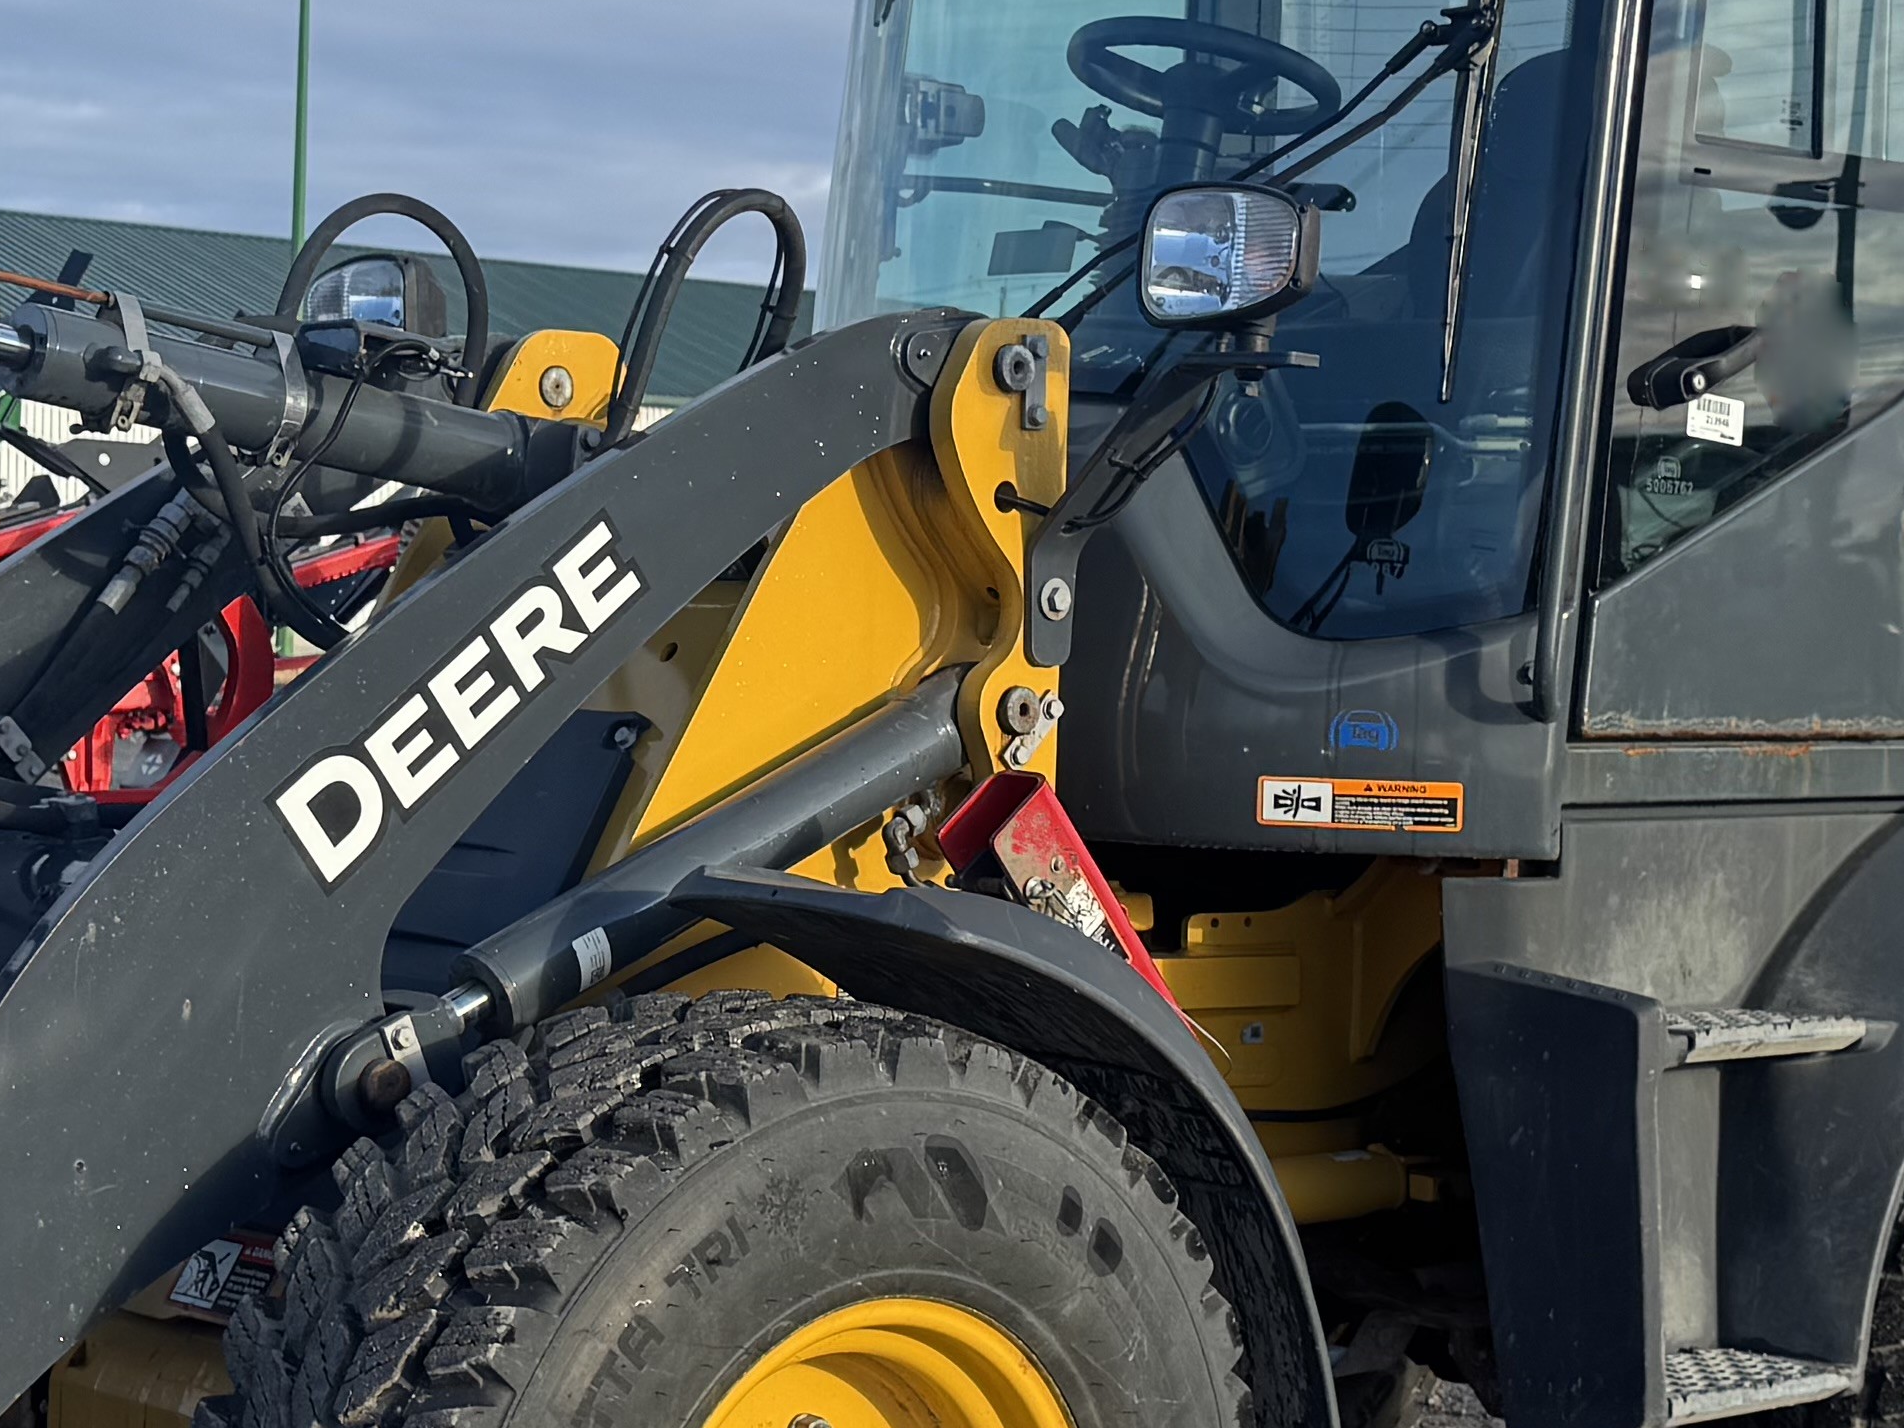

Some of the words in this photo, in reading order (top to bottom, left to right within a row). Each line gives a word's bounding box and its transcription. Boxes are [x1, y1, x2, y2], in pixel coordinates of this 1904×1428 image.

[276, 520, 641, 883] DEERE
[1353, 725, 1379, 743] Tag
[1377, 783, 1427, 794] WARNING
